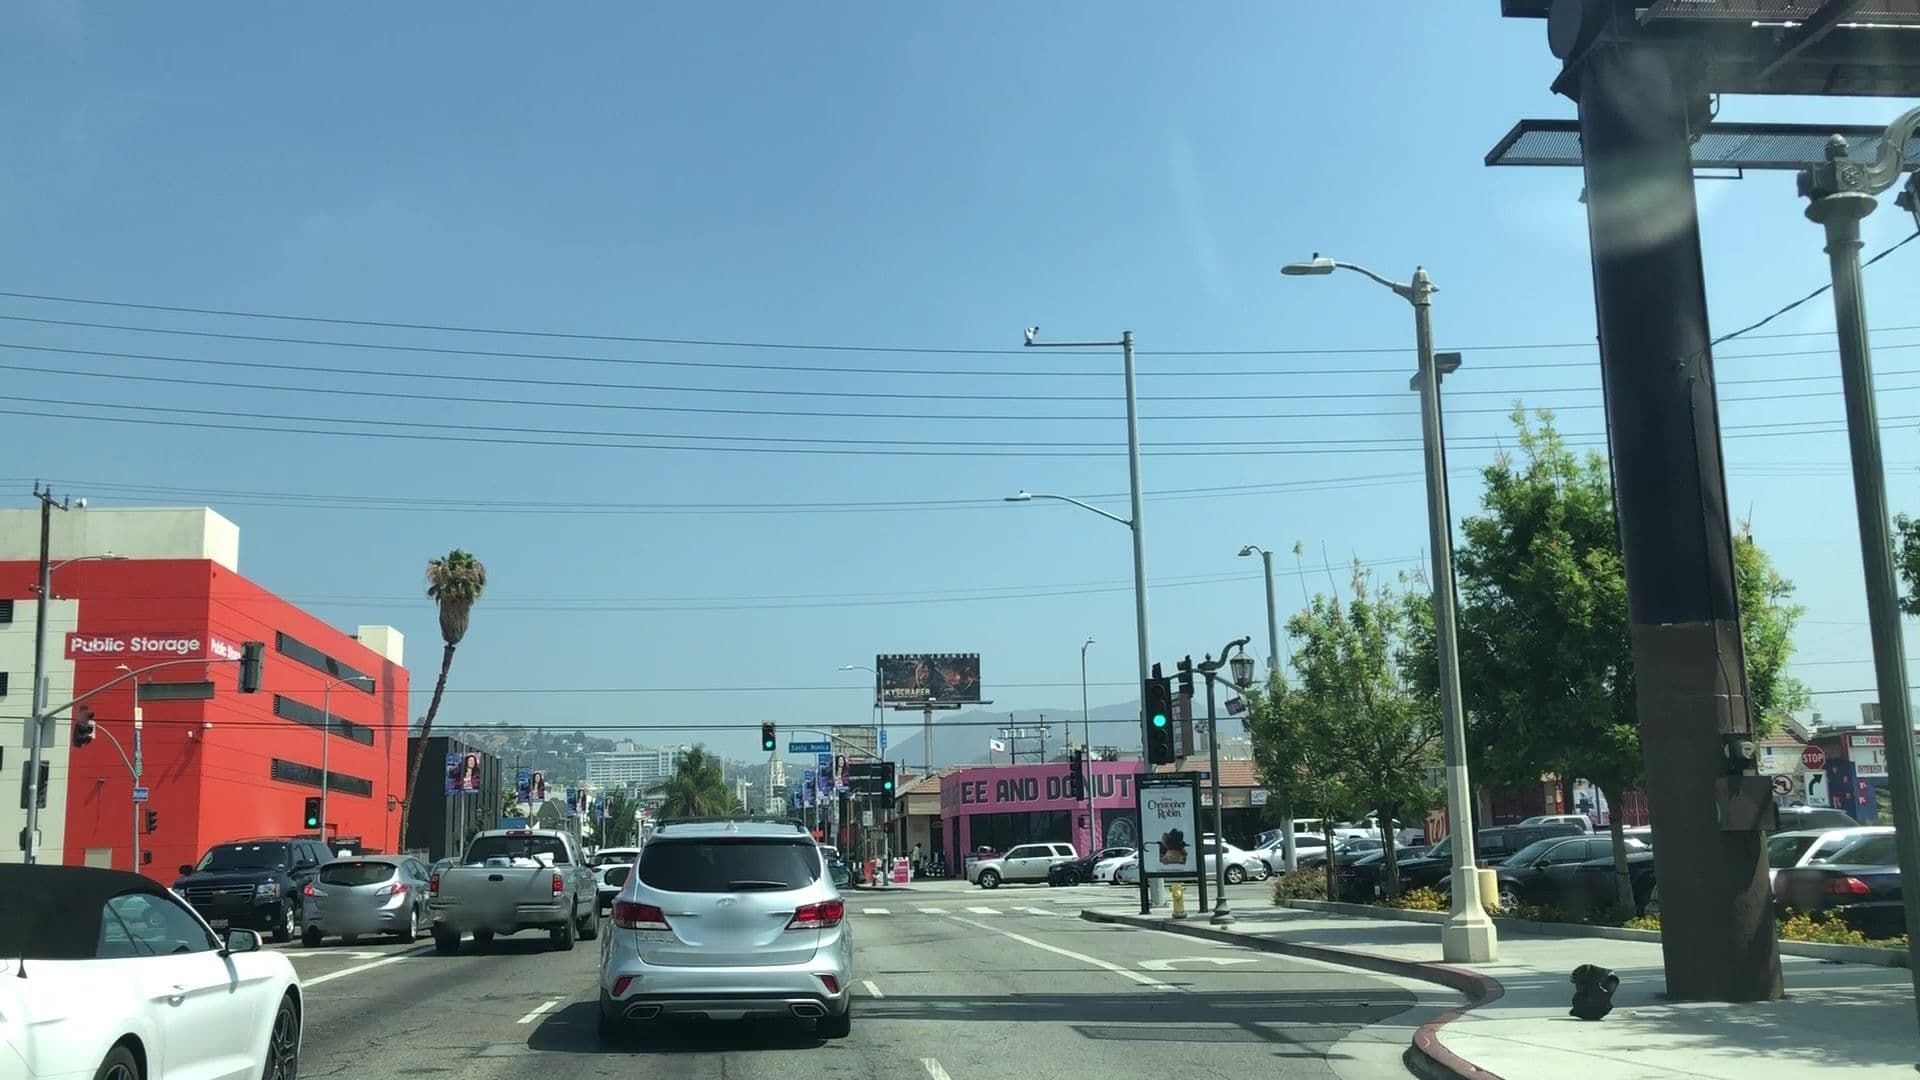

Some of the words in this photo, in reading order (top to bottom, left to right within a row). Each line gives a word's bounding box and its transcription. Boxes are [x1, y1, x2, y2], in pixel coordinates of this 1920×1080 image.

[71, 637, 125, 652] Public
[130, 636, 200, 655] Storage
[790, 743, 808, 752] Santa
[811, 743, 830, 752] Monica
[1802, 753, 1825, 764] STOP
[995, 776, 1040, 804] AND
[1147, 799, 1187, 811] Christopher
[1157, 806, 1182, 820] Robin
